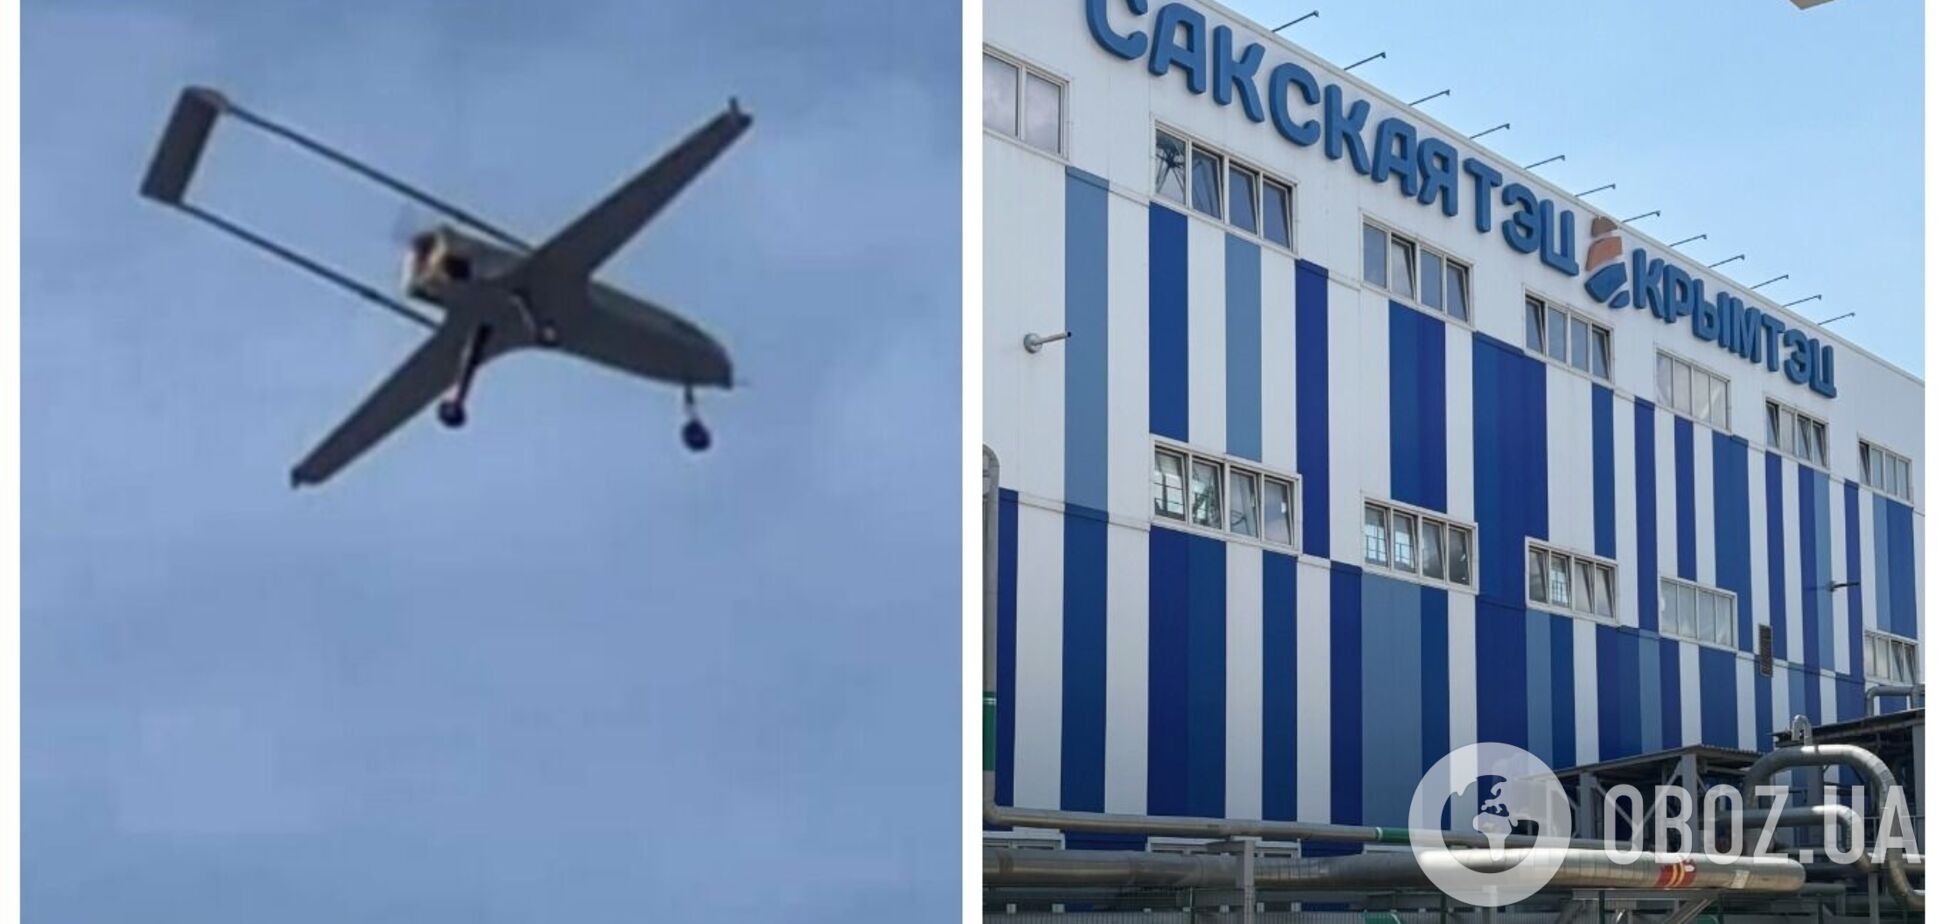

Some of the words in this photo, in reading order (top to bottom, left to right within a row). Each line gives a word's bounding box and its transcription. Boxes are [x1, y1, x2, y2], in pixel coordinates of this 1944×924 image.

[1086, 0, 1458, 217] САКСКАЯ
[1463, 156, 1579, 276] ТЭЦ
[1632, 248, 1837, 398] КРЫМТЭЦ
